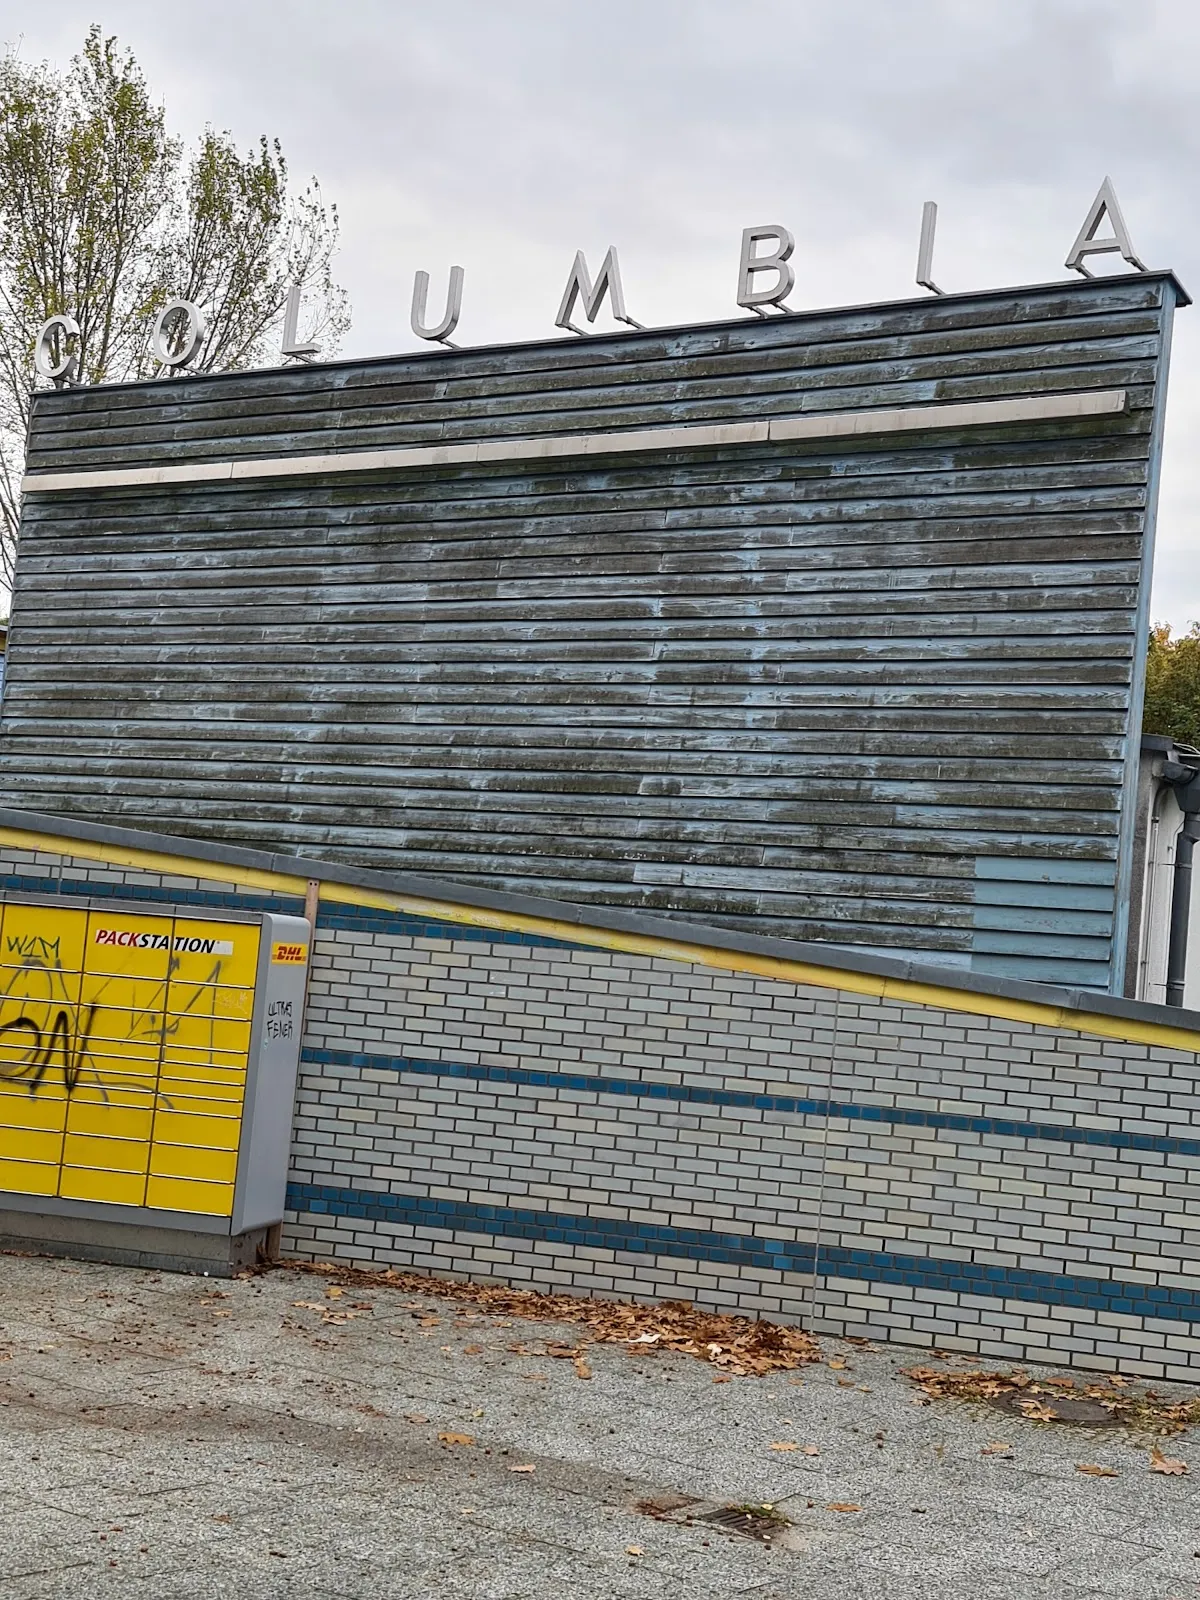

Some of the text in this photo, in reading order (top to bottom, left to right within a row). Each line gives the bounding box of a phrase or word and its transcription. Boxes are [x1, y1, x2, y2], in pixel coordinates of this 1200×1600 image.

[35, 176, 1138, 380] COLUMBIA
[95, 929, 216, 954] PACKSTATION
[276, 945, 303, 961] DHL
